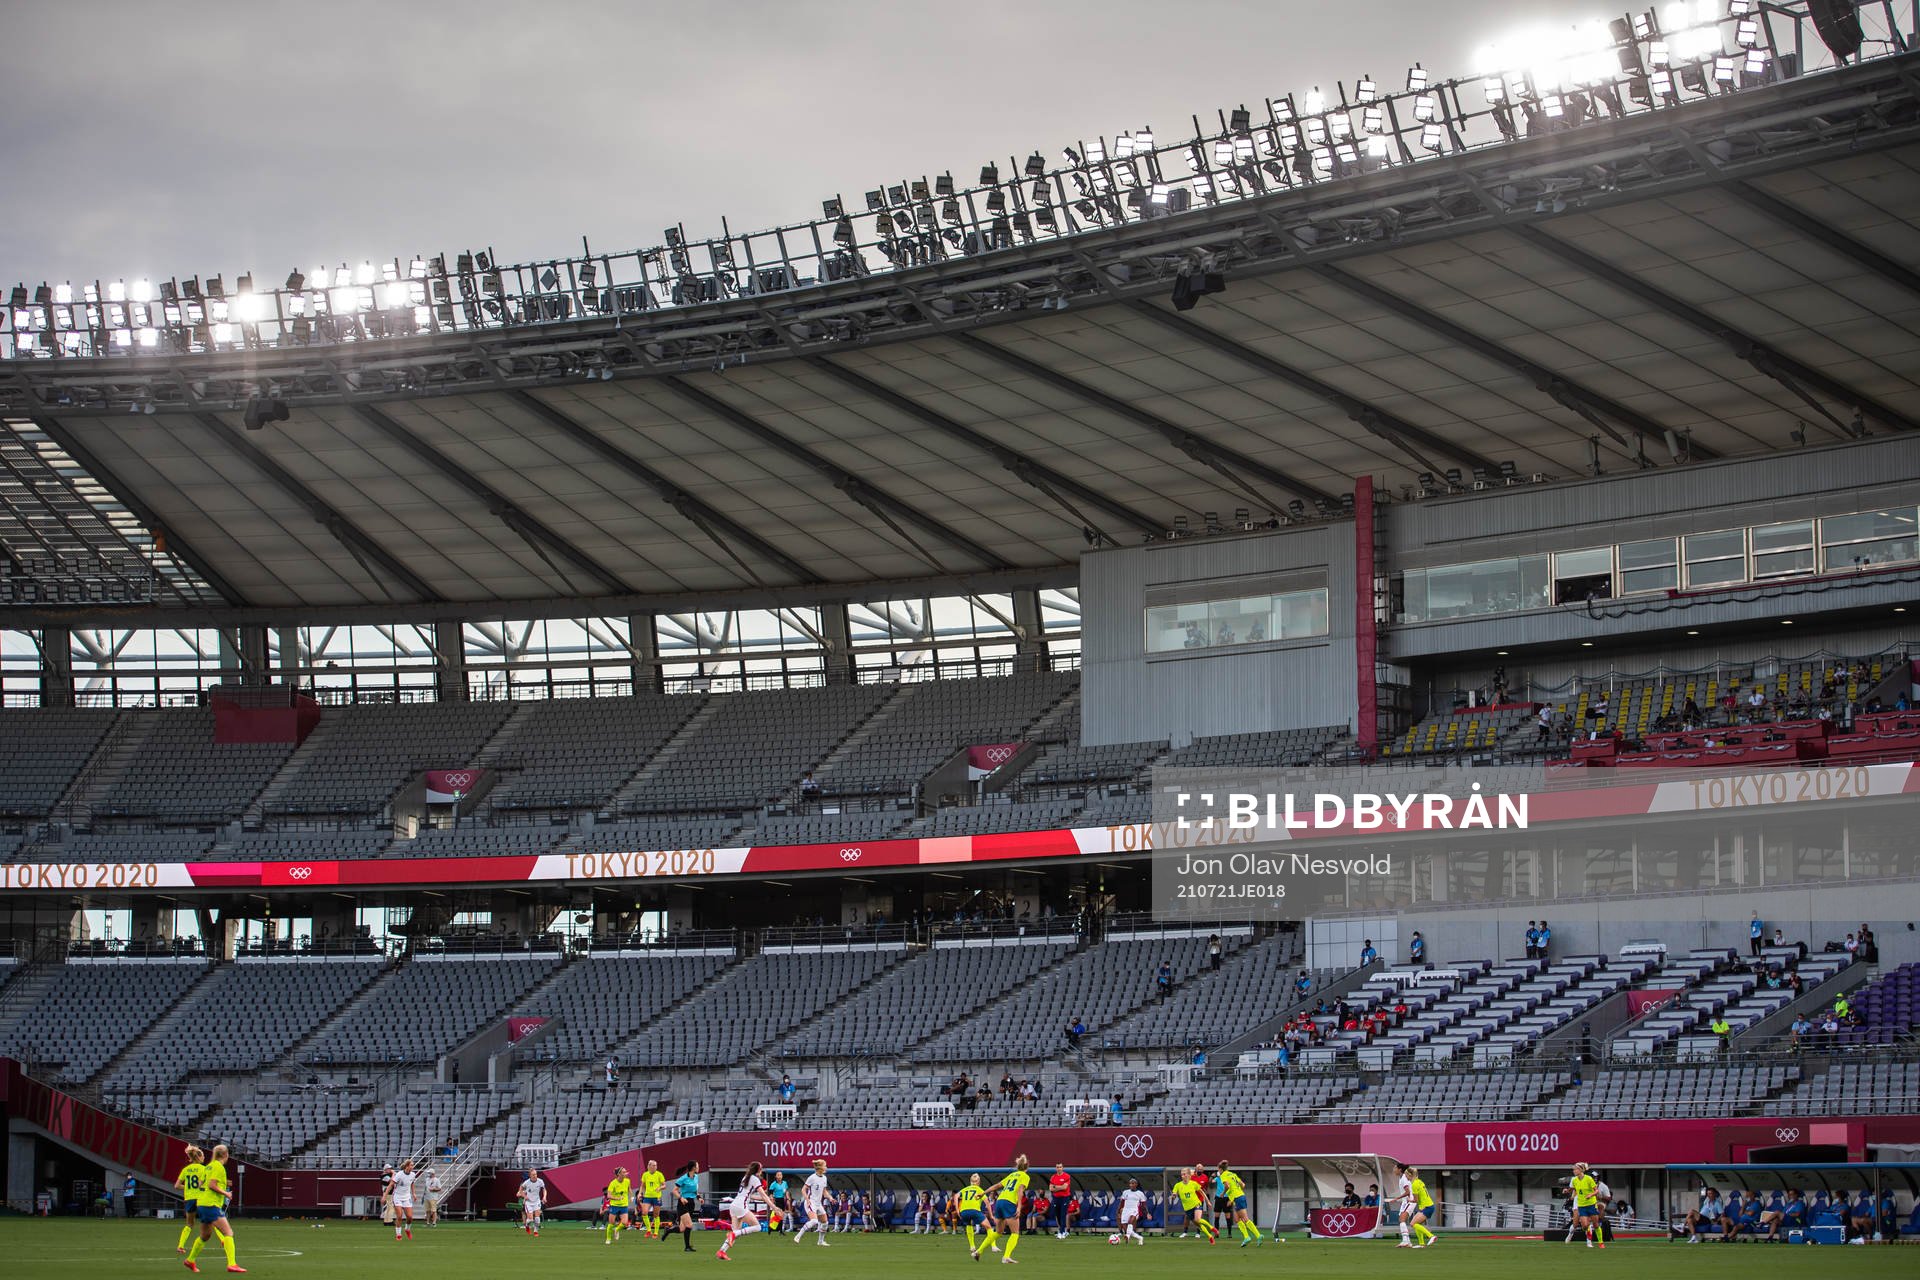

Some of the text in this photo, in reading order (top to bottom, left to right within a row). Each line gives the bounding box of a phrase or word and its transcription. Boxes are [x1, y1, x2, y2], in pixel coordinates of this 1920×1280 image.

[1689, 766, 1870, 809] TOKYO 2020
[1106, 822, 1188, 852] TOKYO
[565, 849, 715, 879] TOKYO 2020
[1, 864, 158, 888] TOKYO 2020
[100, 1116, 169, 1178] 2020
[763, 1141, 837, 1157] TOKYO 2020
[1465, 1133, 1559, 1152] TOKYO 2020
[186, 1175, 199, 1190] 18
[1003, 1179, 1018, 1192] 14
[963, 1190, 977, 1201] 17
